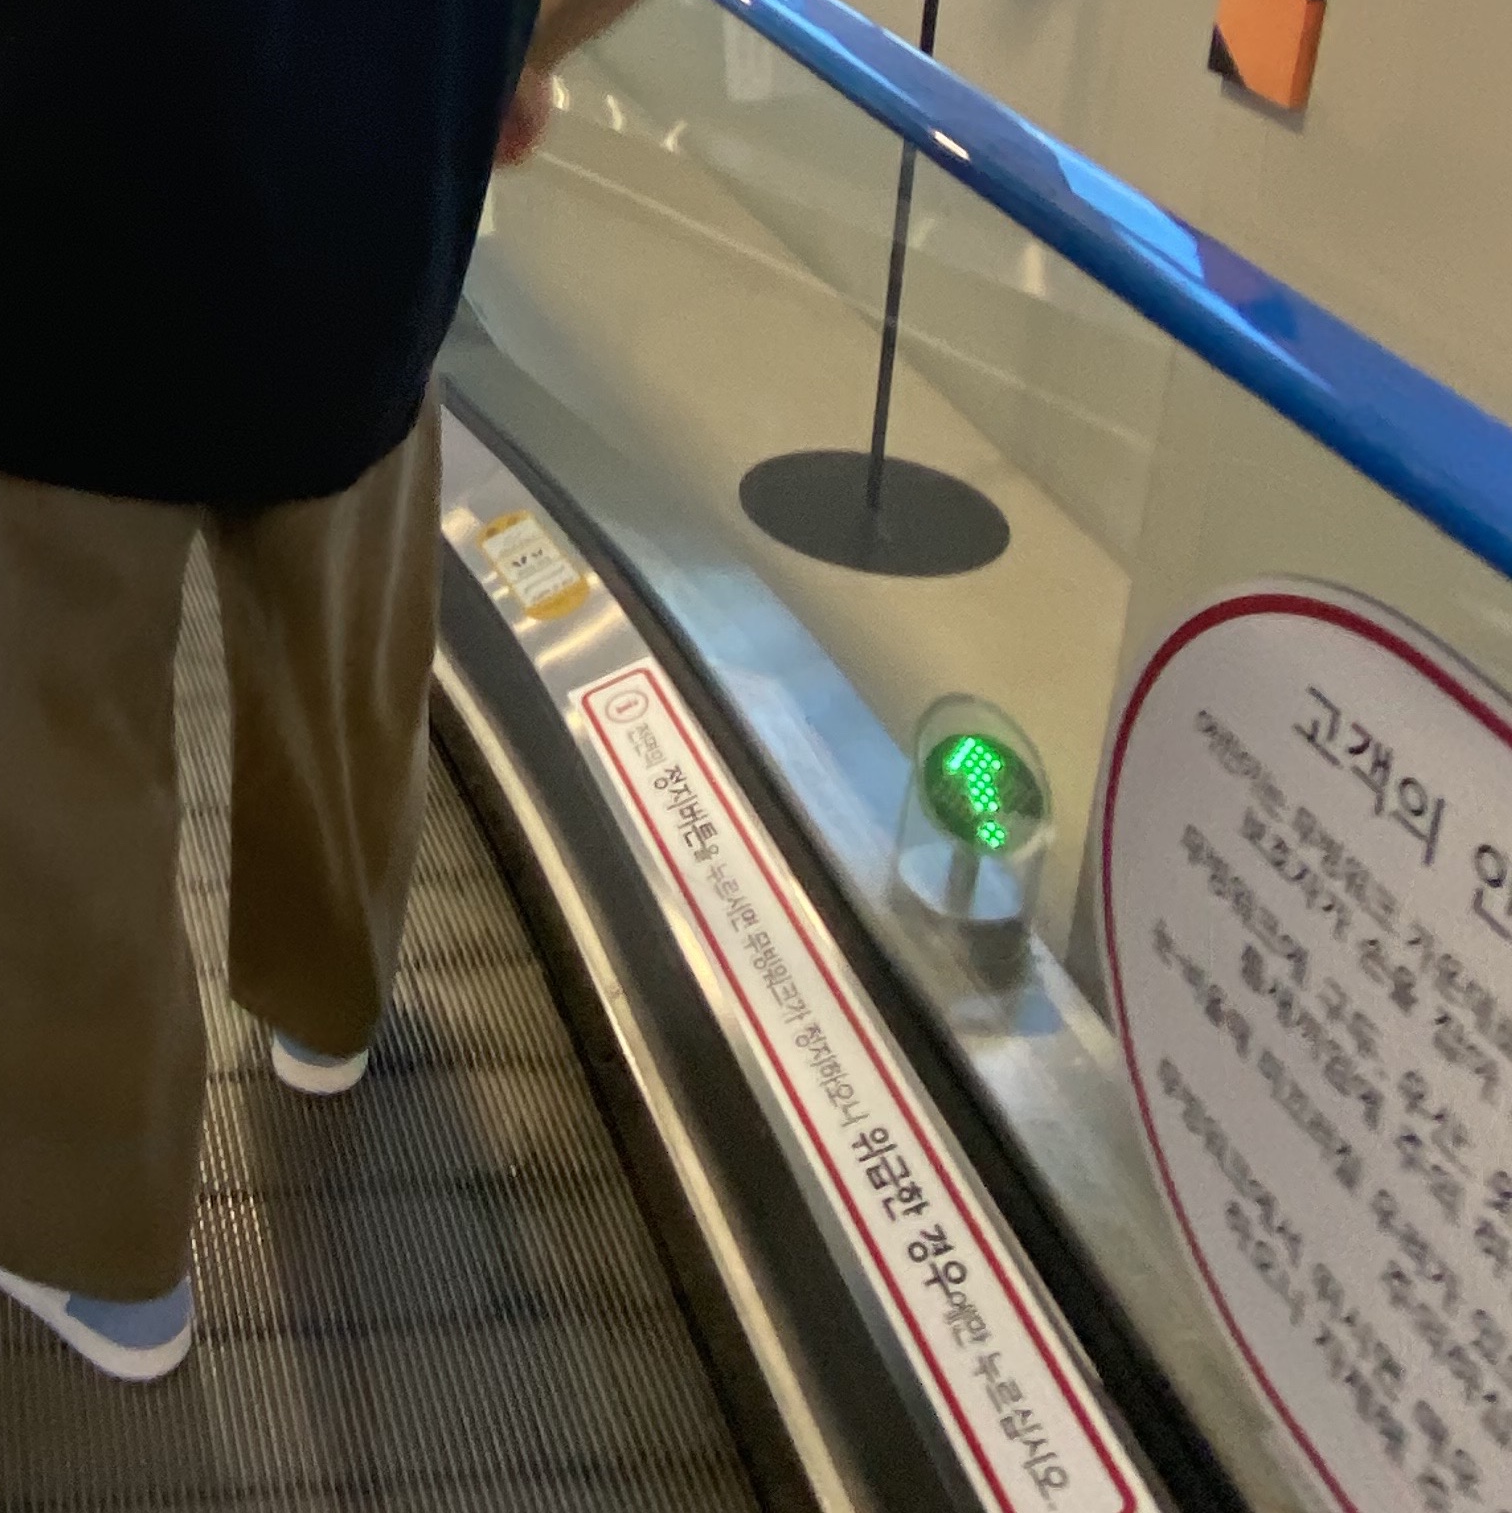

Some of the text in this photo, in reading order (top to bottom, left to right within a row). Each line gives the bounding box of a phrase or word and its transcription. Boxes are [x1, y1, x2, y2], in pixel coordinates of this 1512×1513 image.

[1292, 685, 1445, 866] 고객의
[653, 762, 719, 863] 정지버튼을
[706, 862, 758, 933] 누르시면
[747, 930, 812, 1024] 무빙워크가
[795, 1017, 868, 1128] 정지하오니
[851, 1126, 929, 1222] 위급한
[907, 1223, 992, 1348] 경우에만
